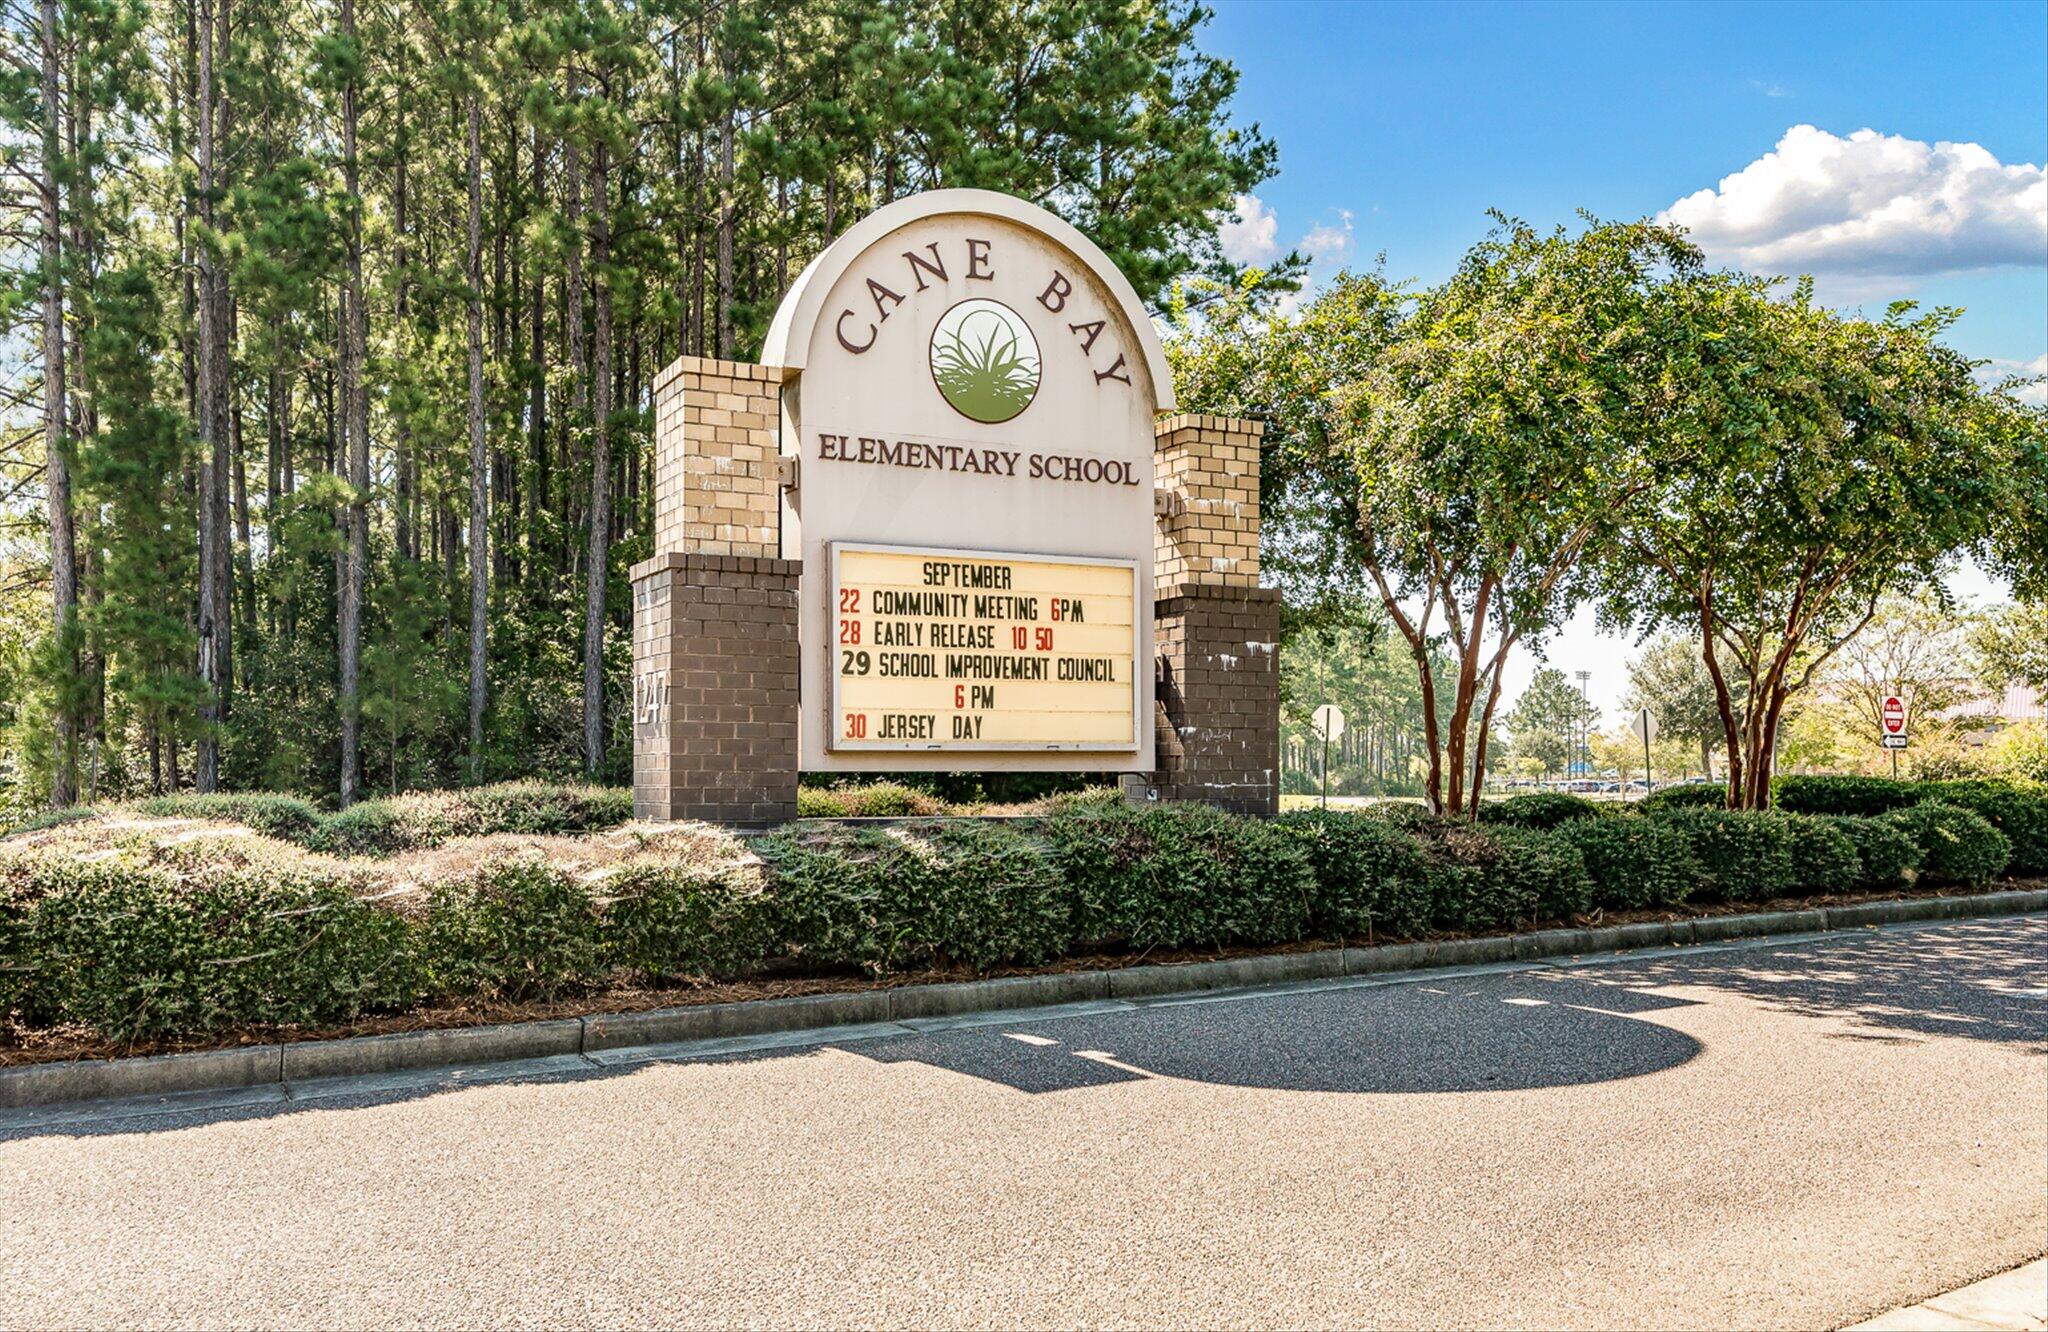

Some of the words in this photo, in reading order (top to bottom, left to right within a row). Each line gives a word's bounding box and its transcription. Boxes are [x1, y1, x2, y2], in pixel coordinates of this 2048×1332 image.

[835, 238, 995, 355] CANE
[1036, 270, 1133, 388] BAY
[818, 434, 1021, 477] ELEMENTARY
[1029, 454, 1141, 487] SCHOOL
[923, 562, 1011, 590] SEPTEMBER
[840, 588, 860, 614] 22
[873, 590, 968, 618] COMMUNITY
[974, 596, 1038, 621] MEETING
[840, 620, 861, 645] 28
[874, 621, 924, 647] EARLY
[930, 625, 996, 649] RELEASE
[1012, 626, 1027, 650] 10
[1035, 627, 1054, 651] 50
[841, 650, 871, 676] 29
[879, 652, 939, 678] SCHOOL
[945, 654, 1050, 681] IMPROVEMENT
[1057, 658, 1115, 682] COUNCIL
[955, 684, 965, 709] 6
[971, 685, 994, 709] PM
[846, 713, 867, 738] 30
[877, 714, 935, 739] JERSEY
[952, 716, 983, 740] DAY
